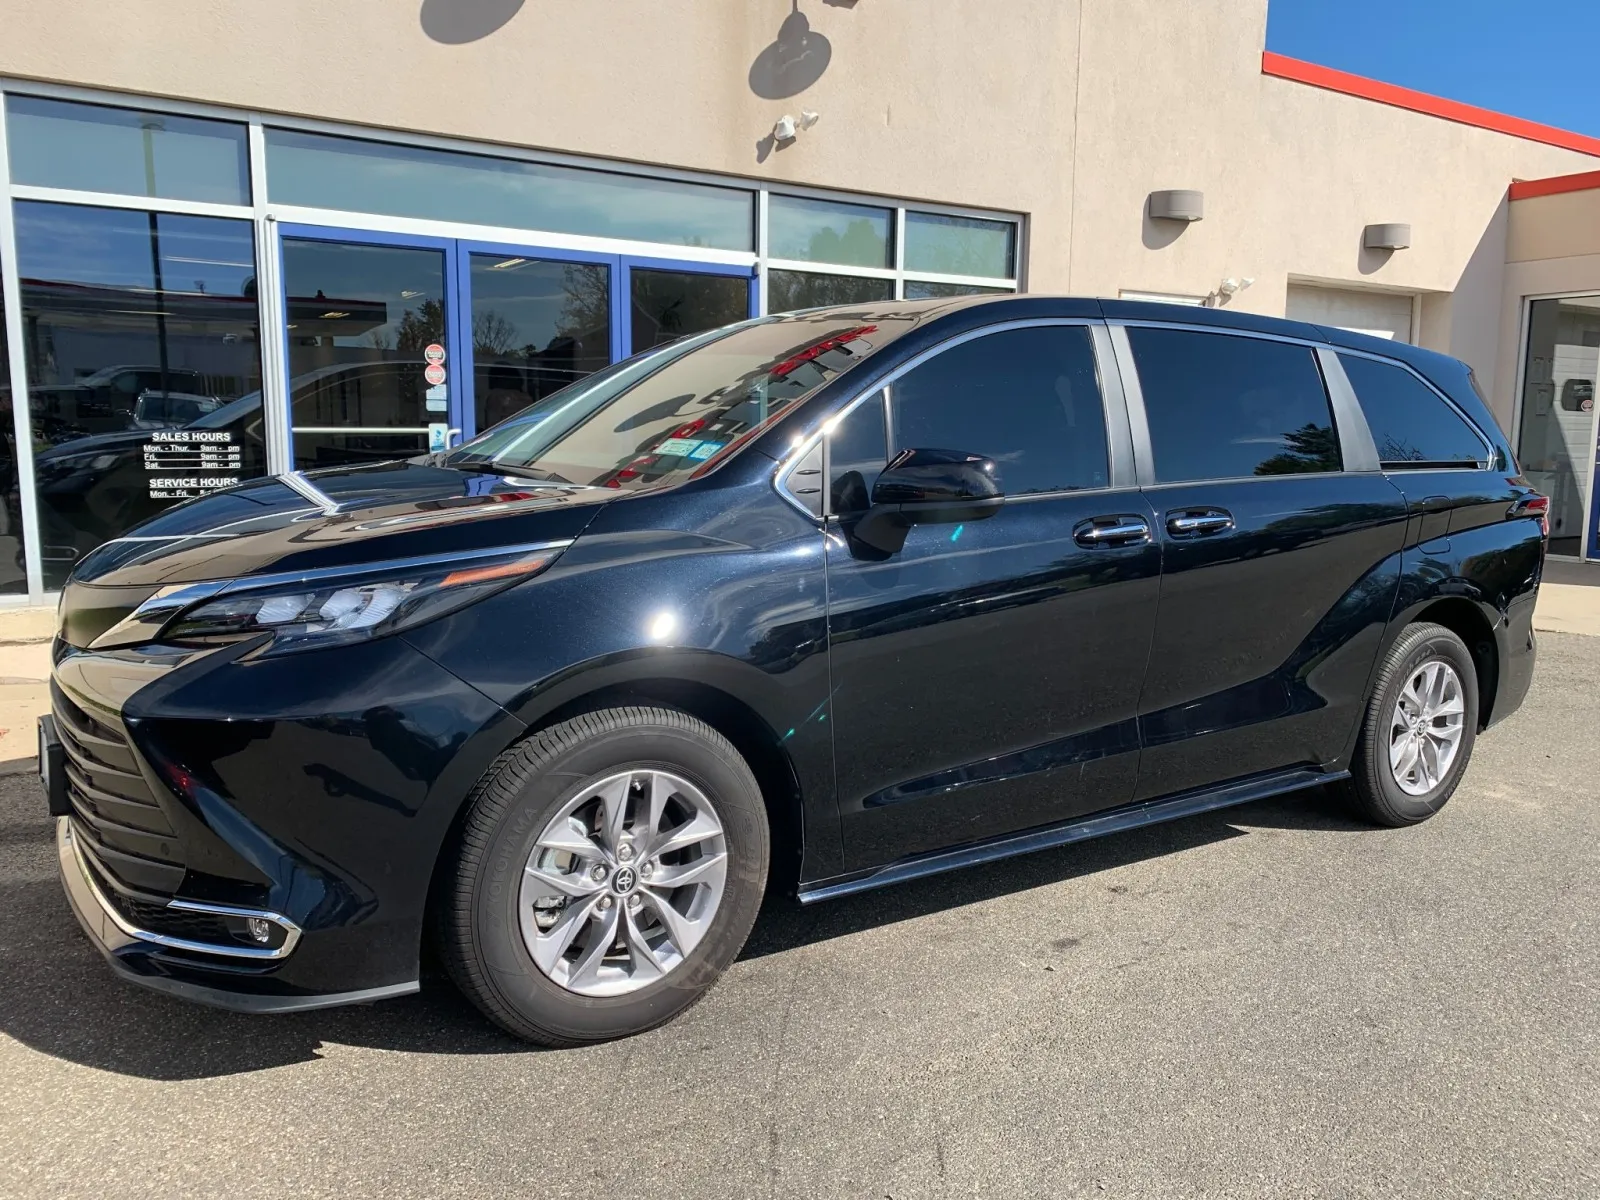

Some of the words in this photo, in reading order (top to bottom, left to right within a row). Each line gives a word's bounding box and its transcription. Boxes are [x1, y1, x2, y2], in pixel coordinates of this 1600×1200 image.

[152, 432, 189, 441] SALES
[192, 432, 231, 441] HOURS
[171, 444, 190, 452] Thur.
[149, 478, 198, 488] SERVICE
[199, 478, 238, 487] HOURS
[487, 807, 538, 904] YOKOHAMA
